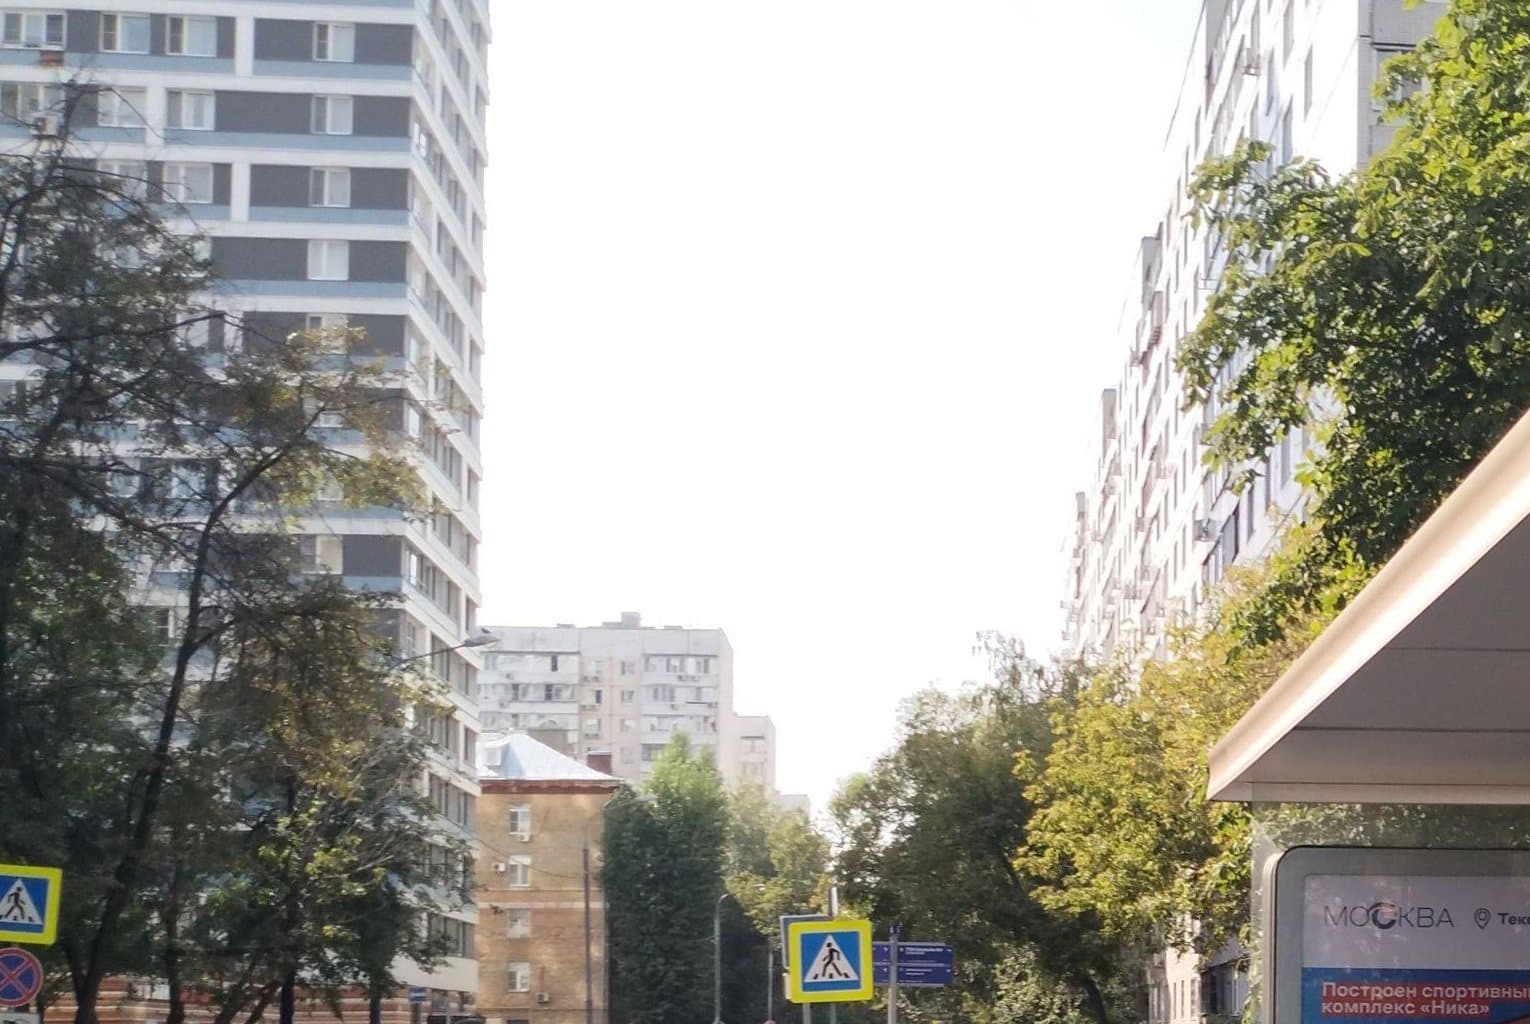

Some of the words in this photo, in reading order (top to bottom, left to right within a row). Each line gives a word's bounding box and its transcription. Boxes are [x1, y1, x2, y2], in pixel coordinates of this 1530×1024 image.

[1324, 902, 1454, 930] МОСКВА
[1322, 982, 1416, 1000] Построен
[1322, 1001, 1415, 1014] комплекс
[1421, 1000, 1490, 1015] «Ника»
